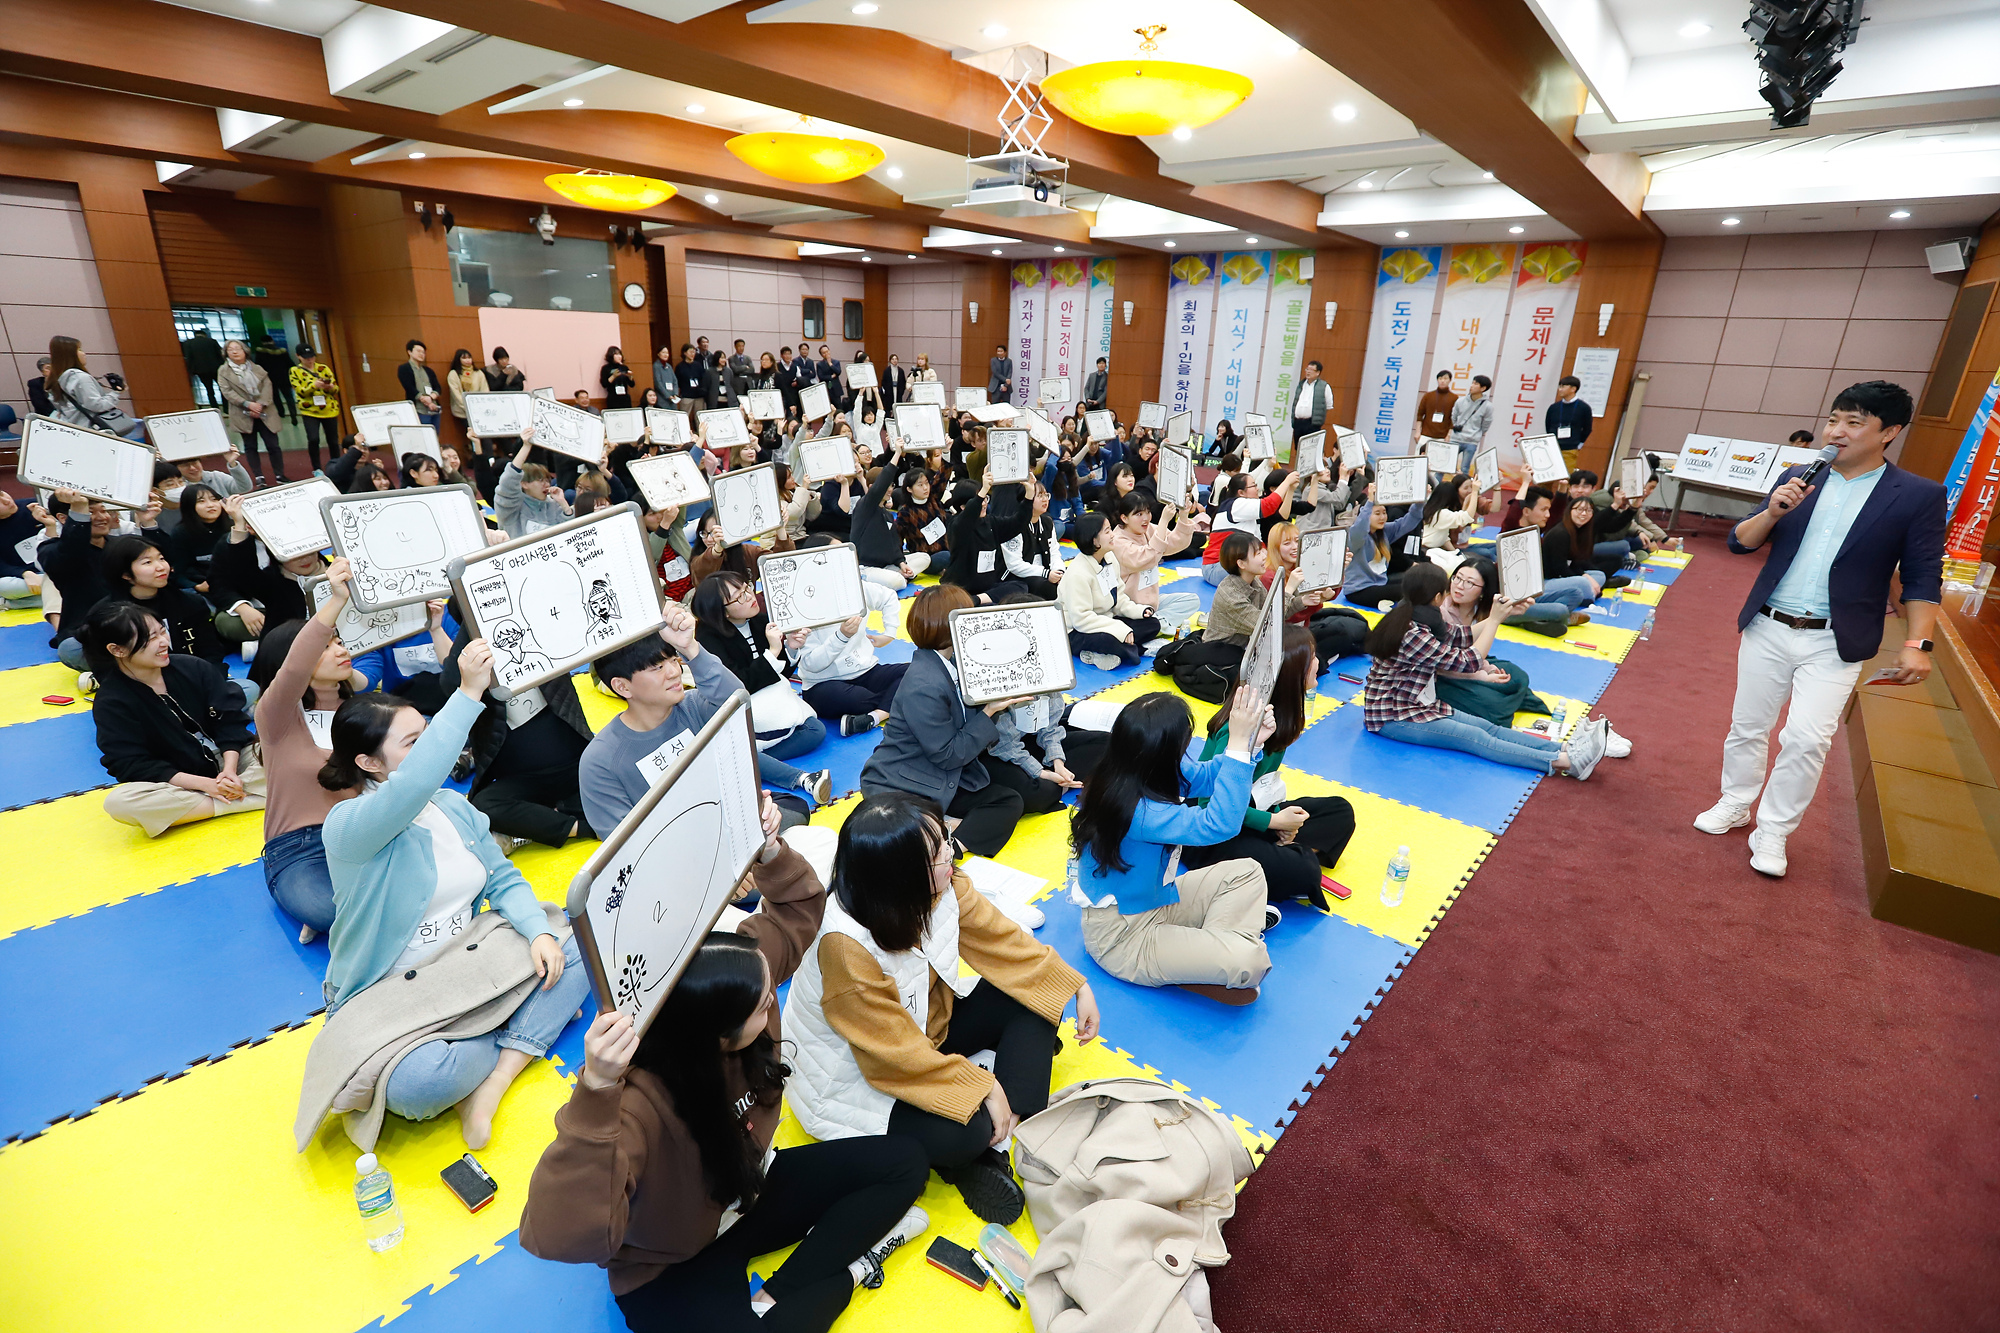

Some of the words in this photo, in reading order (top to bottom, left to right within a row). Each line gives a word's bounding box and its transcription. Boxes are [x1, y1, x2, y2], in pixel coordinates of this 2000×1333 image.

[1021, 299, 1034, 333] 가자!
[1059, 299, 1074, 328] 아는
[1180, 299, 1198, 336] 최후의
[1229, 308, 1249, 352] 지식!
[1390, 300, 1412, 350] 도전!
[1058, 332, 1073, 359] 것이
[1278, 299, 1304, 367] 골든벨을
[1456, 317, 1481, 354] 내가
[1524, 306, 1556, 365] 문제가
[1019, 337, 1032, 372] 명예의
[1177, 341, 1192, 376] 1인을
[1018, 375, 1031, 408] 전당!
[1173, 379, 1191, 413] 찾아라
[1222, 358, 1243, 421] 서바이벌
[1271, 376, 1292, 435] 울려라!
[1373, 356, 1404, 443] 독서골든벨
[1511, 373, 1542, 449] 남느냐?
[415, 569, 431, 578] Merry
[549, 606, 561, 620] 4
[522, 699, 539, 715] 2
[418, 913, 464, 944] 한성
